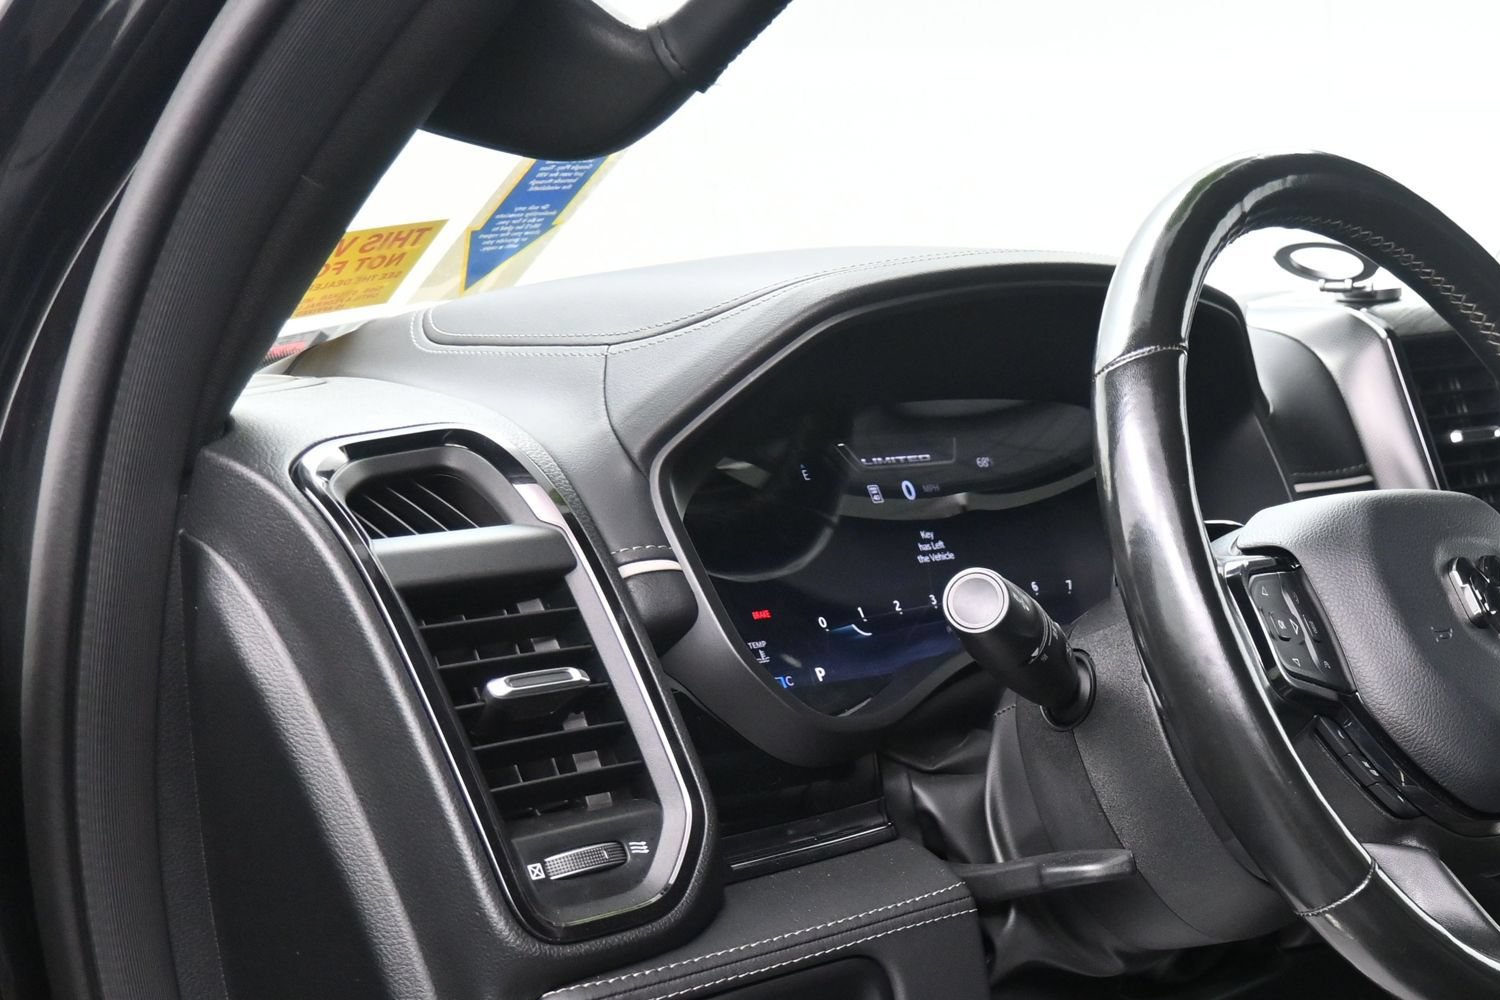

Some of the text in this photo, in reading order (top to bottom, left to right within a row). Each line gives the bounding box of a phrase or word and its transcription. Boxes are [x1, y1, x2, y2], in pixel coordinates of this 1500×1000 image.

[861, 454, 931, 465] LIMITED
[901, 480, 917, 501] 0
[920, 530, 934, 541] Key
[917, 540, 946, 551] has Left
[916, 552, 955, 564] the Vehicle
[1031, 581, 1039, 592] 6
[818, 594, 938, 629] 0 1 2 3
[747, 640, 767, 649] TEMP
[814, 666, 826, 682] P
